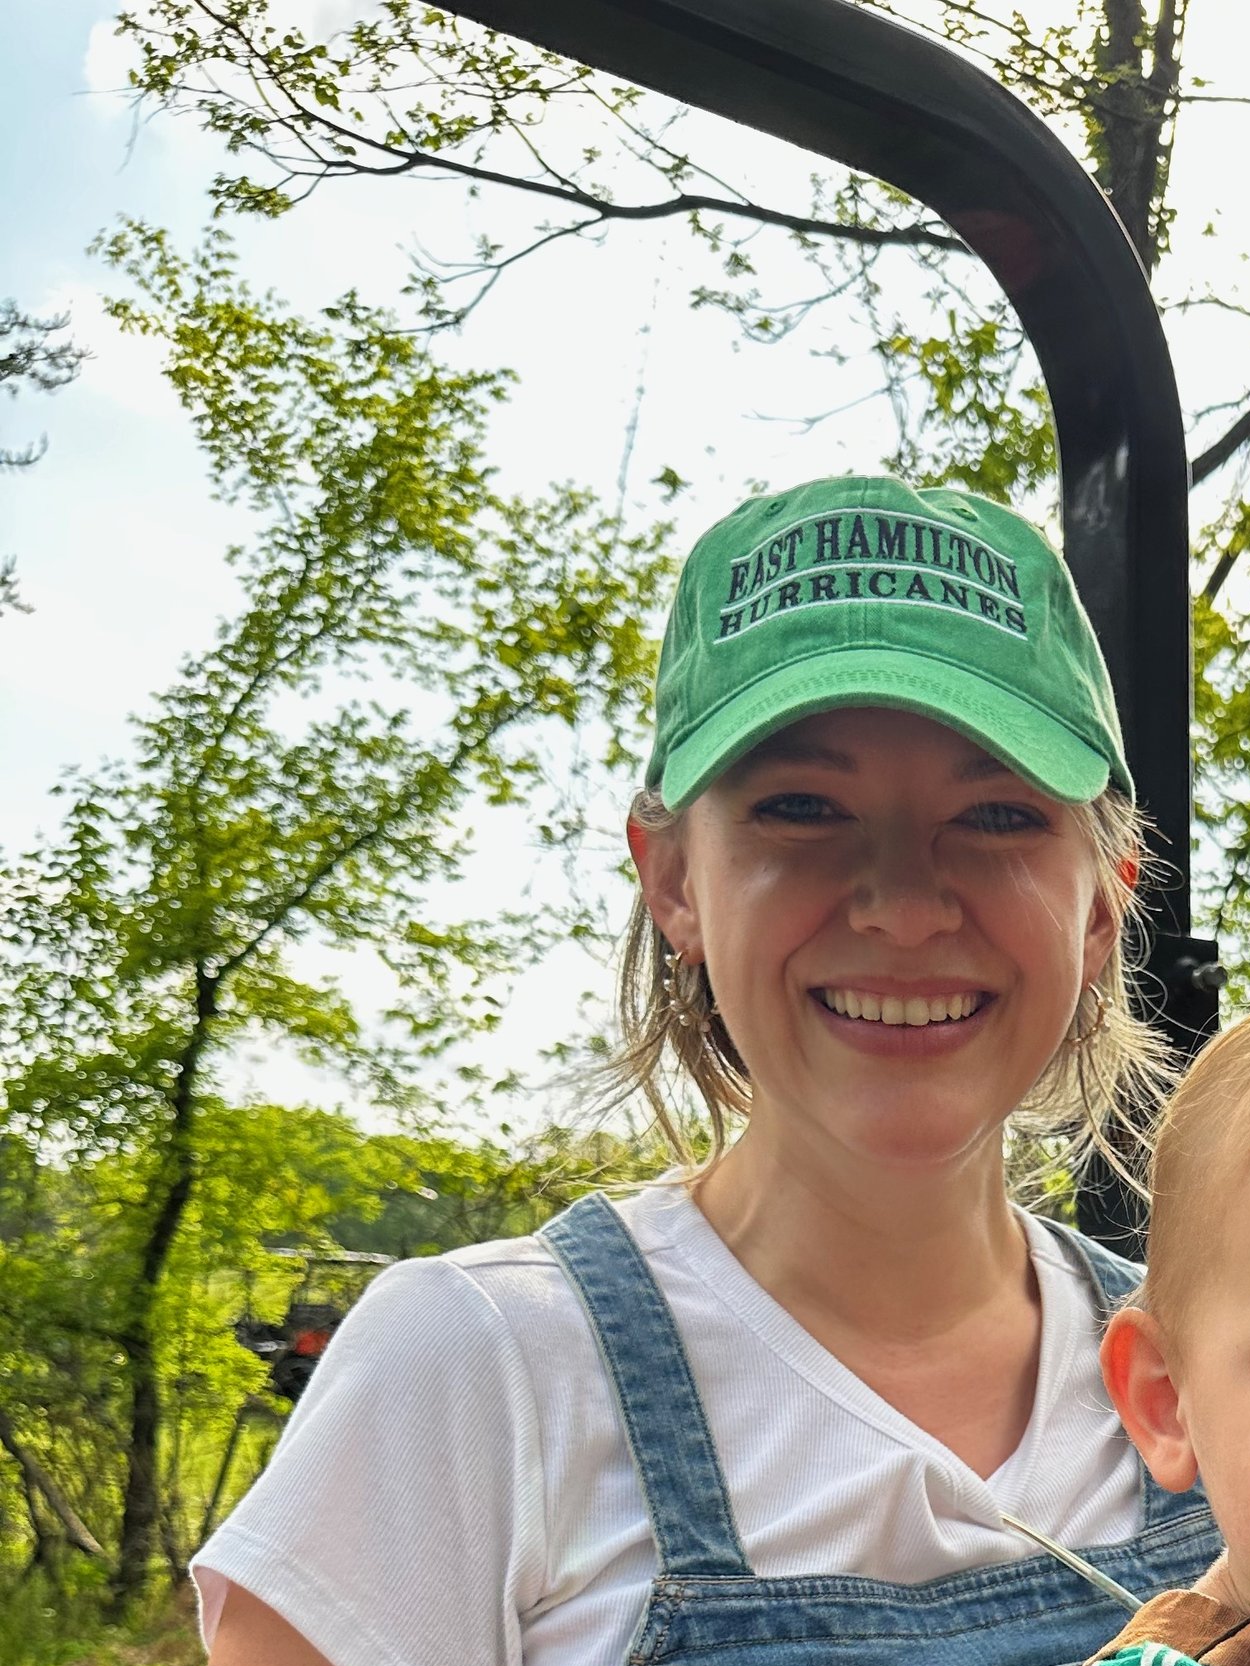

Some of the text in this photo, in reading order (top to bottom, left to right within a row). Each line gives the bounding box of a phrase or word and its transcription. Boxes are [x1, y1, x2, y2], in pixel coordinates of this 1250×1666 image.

[725, 514, 1021, 604] EAST HAMILTON
[715, 570, 1028, 638] HURRICANES
